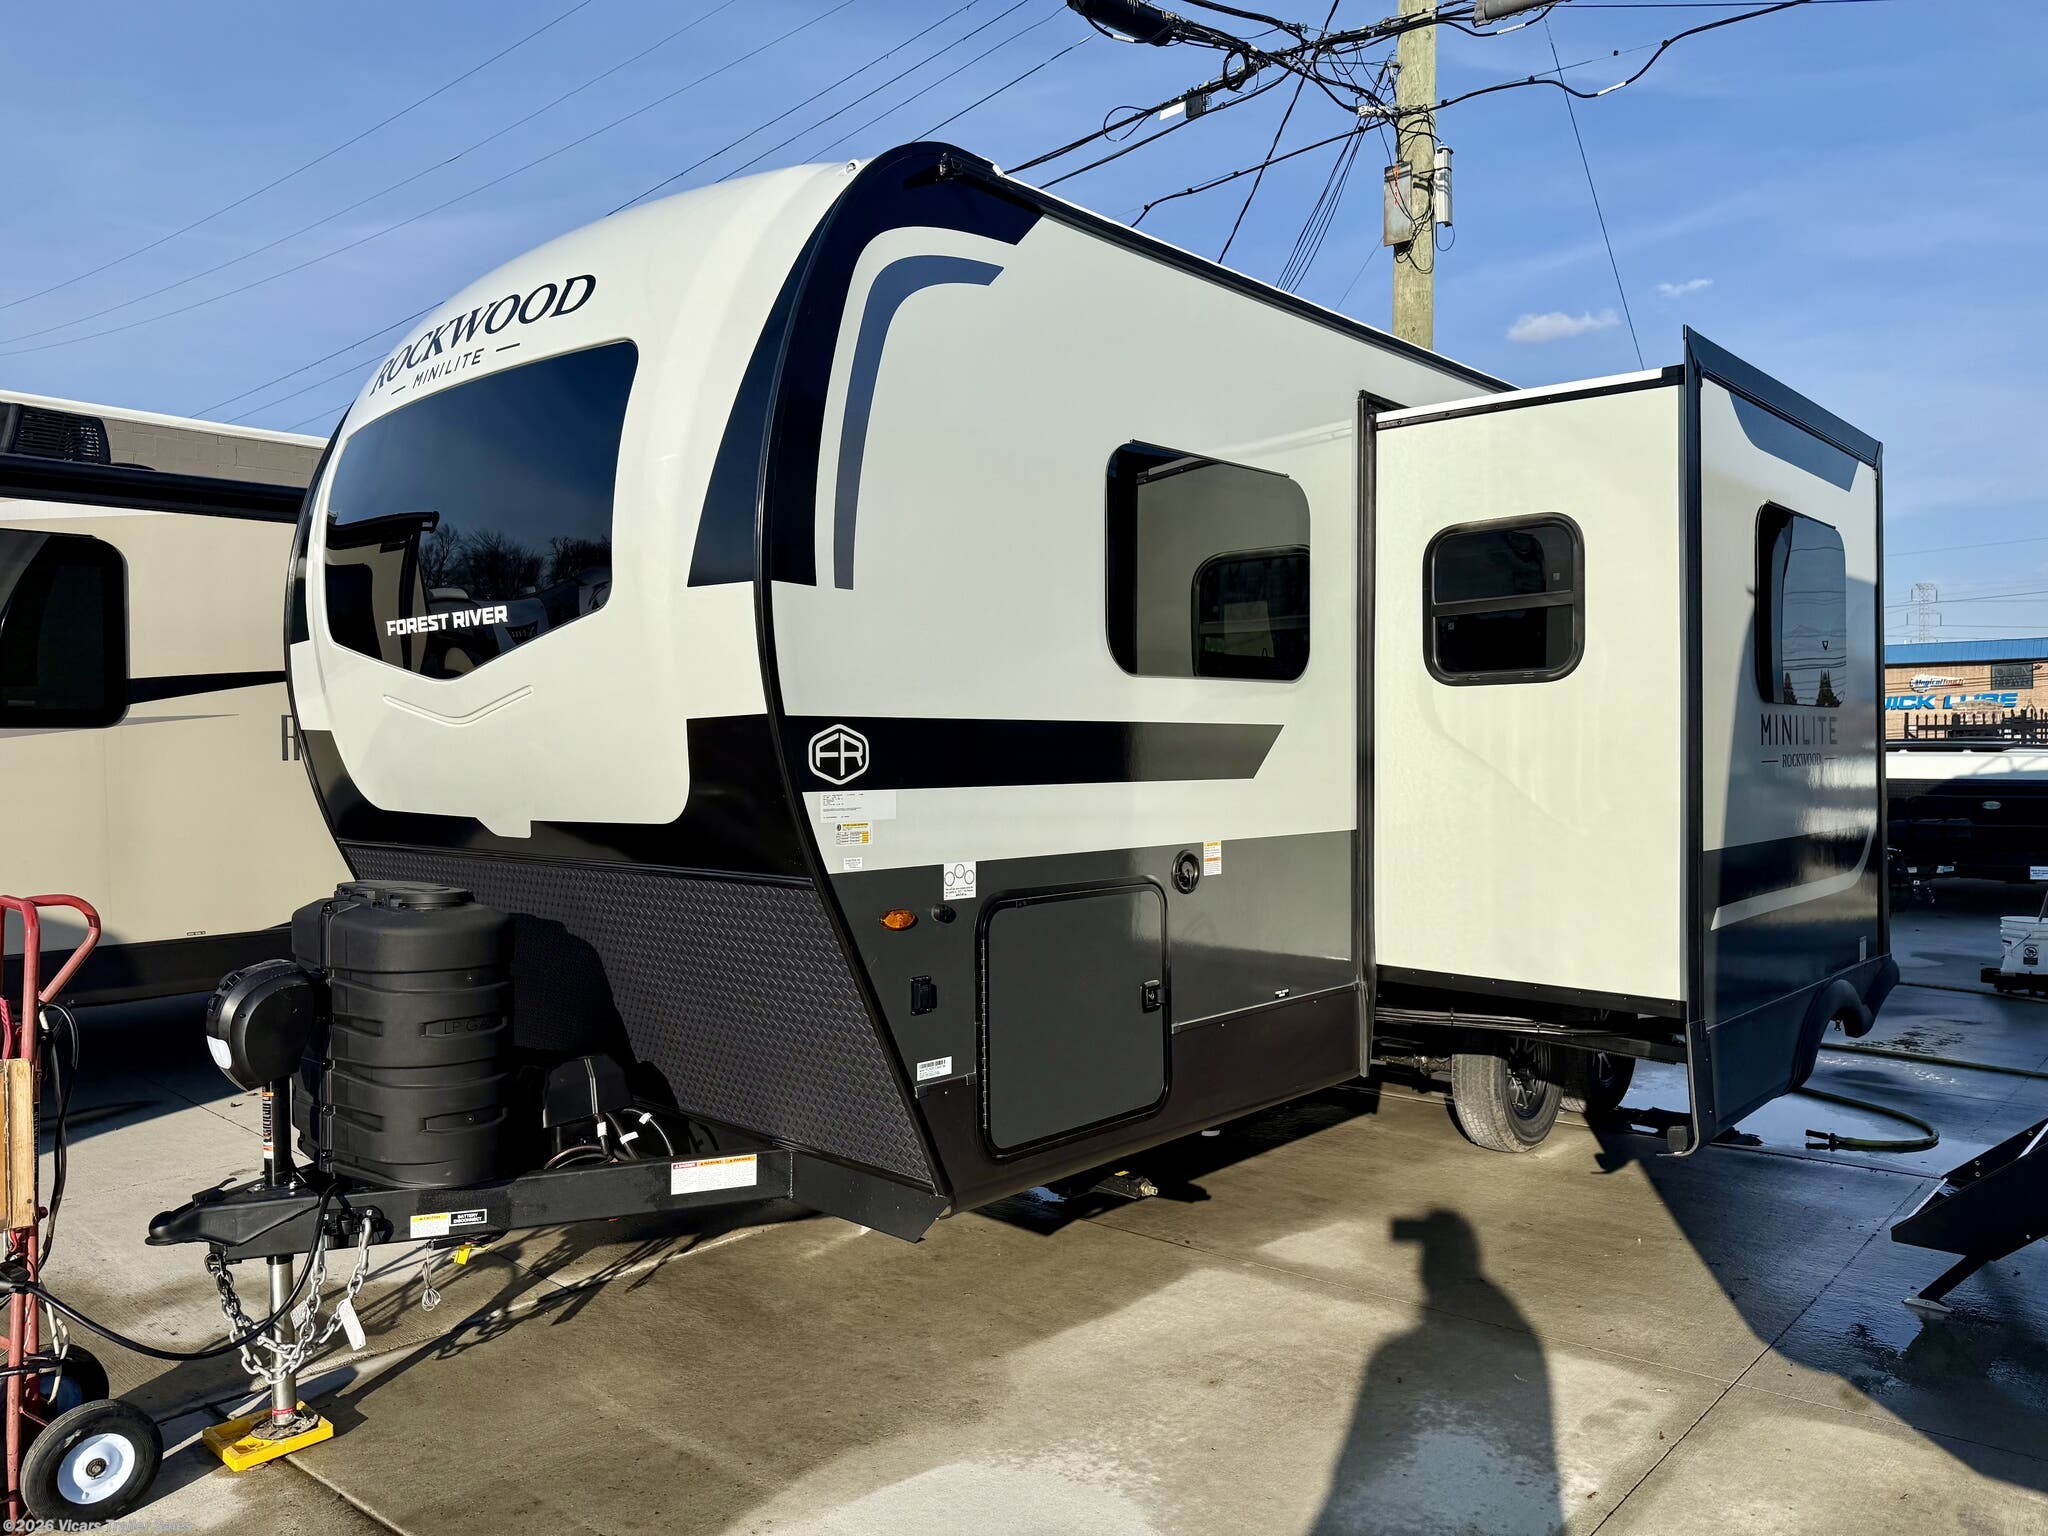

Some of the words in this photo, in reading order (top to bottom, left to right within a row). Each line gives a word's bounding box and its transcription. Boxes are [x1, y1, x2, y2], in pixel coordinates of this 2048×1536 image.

[369, 274, 596, 396] ROCKWOOD
[412, 347, 485, 389] MINILITE
[386, 612, 450, 637] FOREST
[451, 605, 509, 629] RIVER
[1760, 713, 1838, 746] MINILITE
[1782, 752, 1822, 768] ROCKWOOD
